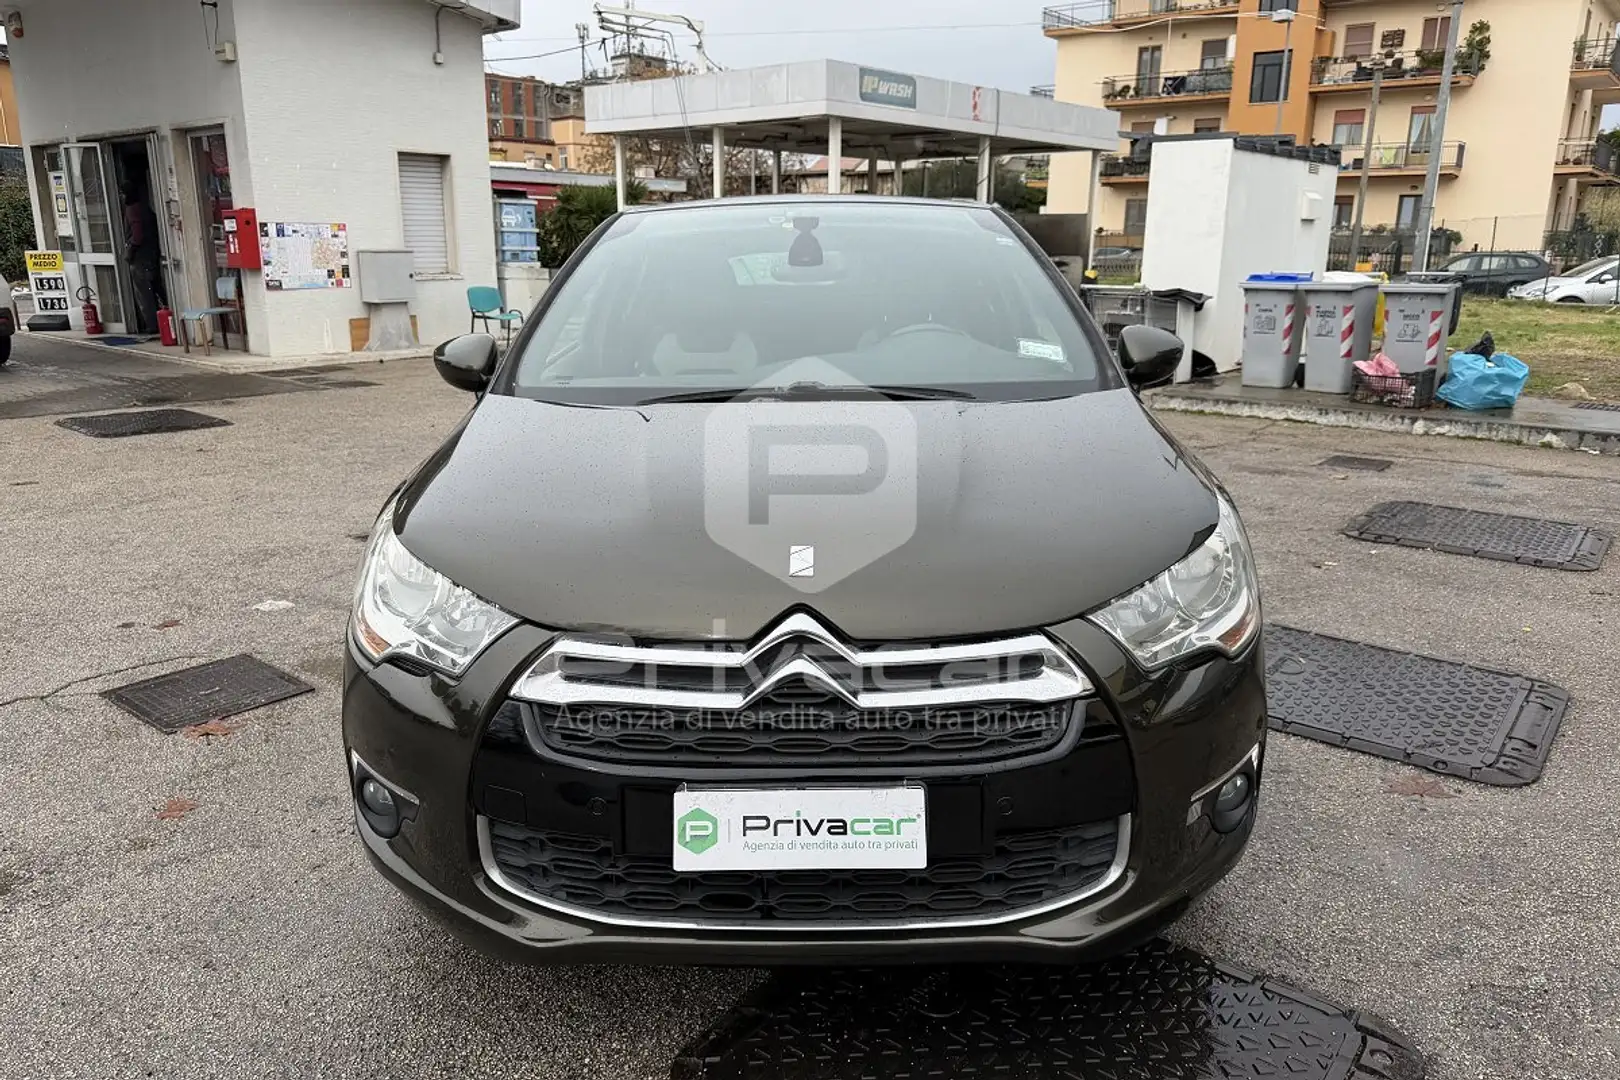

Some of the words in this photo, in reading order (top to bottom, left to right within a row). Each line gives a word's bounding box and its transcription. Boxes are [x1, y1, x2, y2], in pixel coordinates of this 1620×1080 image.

[877, 80, 913, 99] WASH
[29, 253, 58, 261] PREZZO
[685, 820, 713, 842] P
[743, 840, 785, 853] Agenzia
[787, 840, 797, 850] di
[800, 840, 839, 850] vendita
[841, 841, 866, 850] auto
[868, 841, 882, 850] tra
[885, 839, 919, 851] privati
